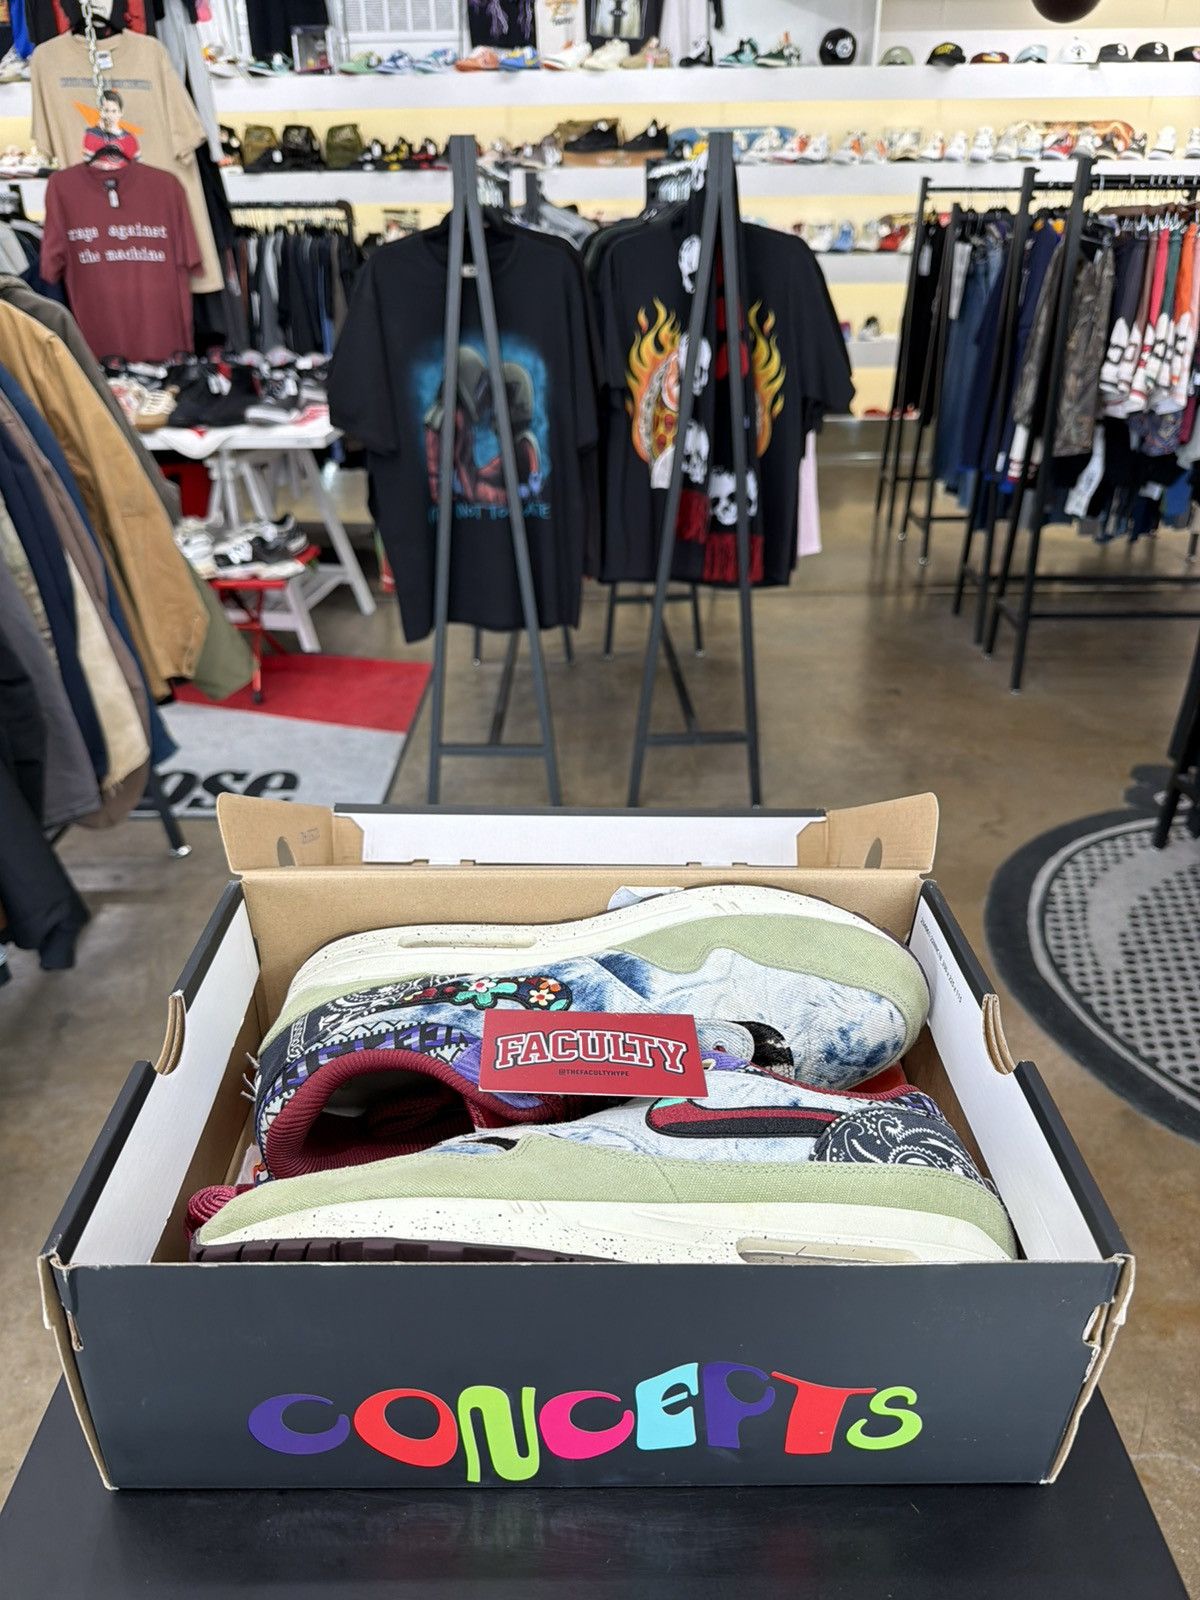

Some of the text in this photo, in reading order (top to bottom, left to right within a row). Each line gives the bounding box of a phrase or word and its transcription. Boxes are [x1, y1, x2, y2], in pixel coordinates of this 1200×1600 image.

[1154, 42, 1164, 55] S
[67, 222, 168, 242] rage against
[79, 246, 166, 264] the machine
[494, 1030, 687, 1074] FACULTY
[558, 1069, 629, 1077] @THEFACULTYHYPE
[248, 1362, 923, 1482] CONCEPTS
